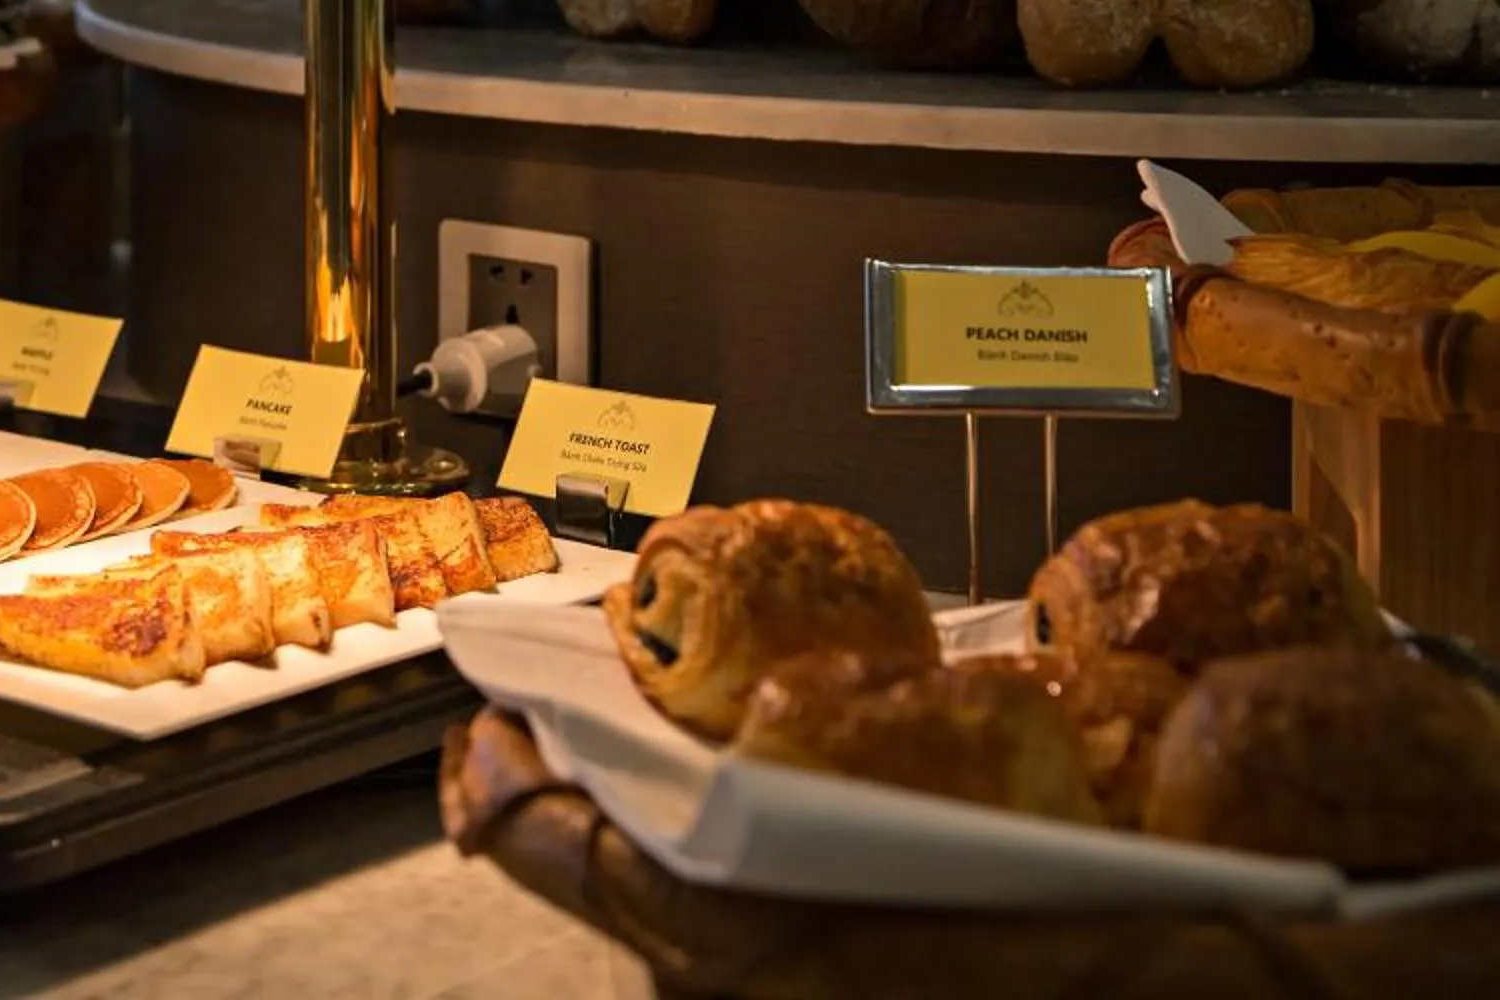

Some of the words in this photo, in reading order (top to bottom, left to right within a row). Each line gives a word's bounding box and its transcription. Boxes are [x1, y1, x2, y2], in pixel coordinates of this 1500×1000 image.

[965, 326, 1020, 341] PEACH
[1023, 328, 1088, 343] DANISH
[245, 397, 293, 416] PANCAKE
[568, 432, 613, 449] FRENCH
[613, 439, 651, 455] TOAST
